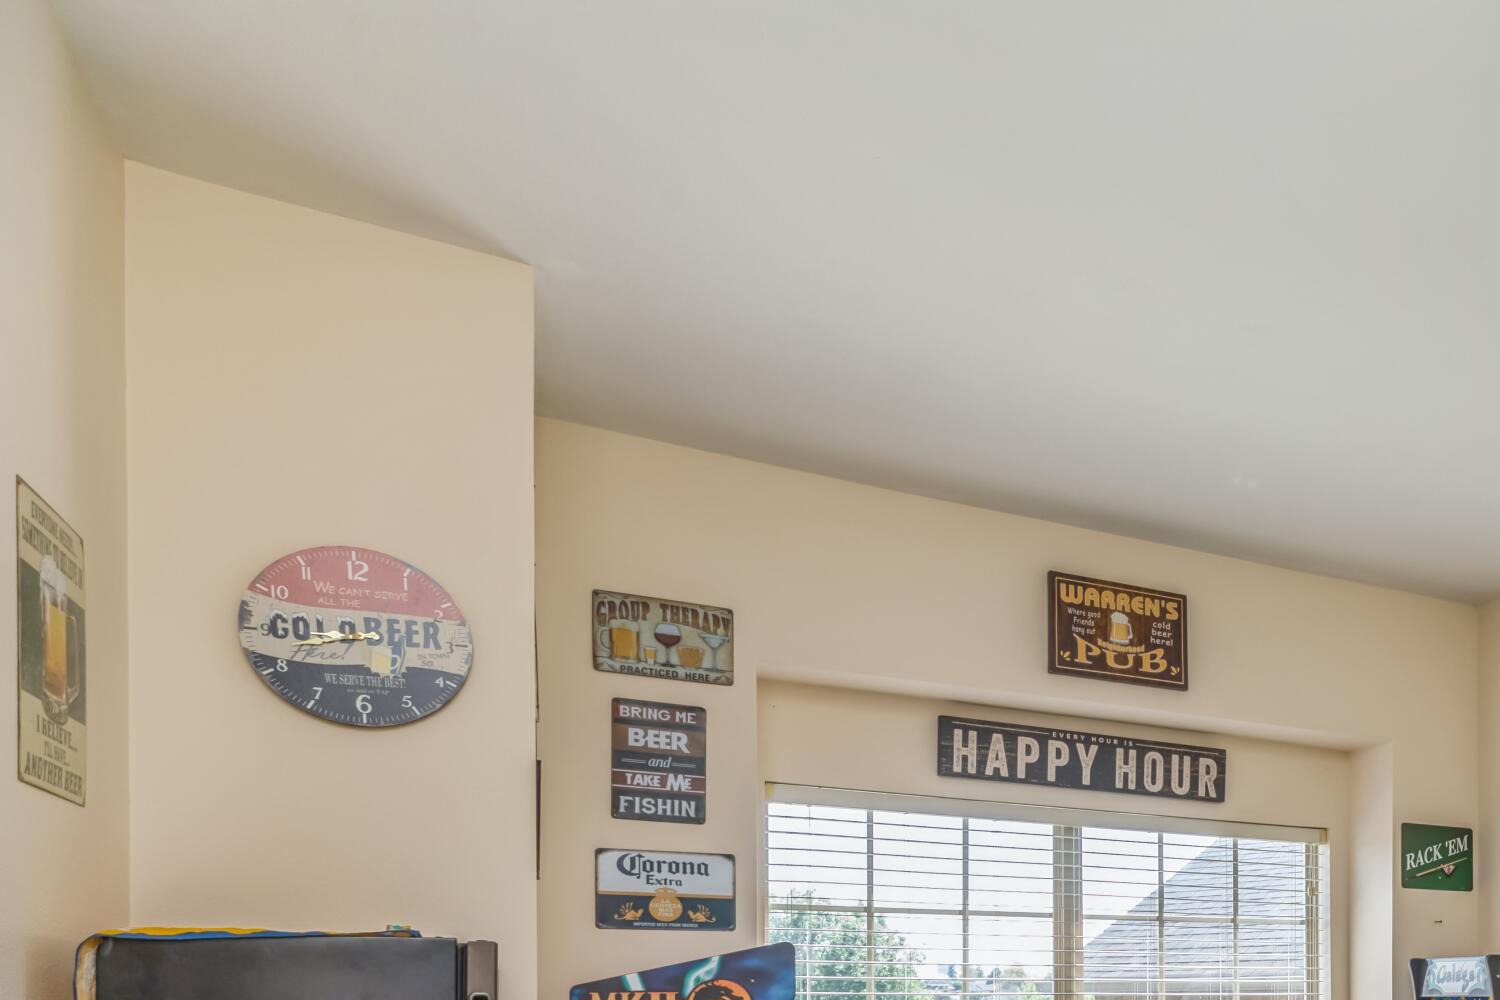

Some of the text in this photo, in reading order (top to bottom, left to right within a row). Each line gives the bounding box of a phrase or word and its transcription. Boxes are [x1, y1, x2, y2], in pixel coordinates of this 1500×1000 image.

[301, 565, 311, 581] 11
[347, 560, 369, 582] 12
[403, 577, 408, 591] 1
[270, 584, 289, 600] 10
[1060, 582, 1179, 620] WARREN'S
[433, 609, 444, 623] 2
[596, 599, 731, 637] GROUP THERAPY
[1067, 607, 1101, 619] Where good
[1073, 616, 1095, 627] Friends
[1153, 621, 1171, 630] cold
[363, 616, 441, 650] BEER
[1072, 624, 1085, 635] hang
[1151, 629, 1172, 638] beer
[445, 641, 454, 654] 3
[1150, 637, 1173, 646] here!
[1073, 633, 1168, 673] PUB
[276, 659, 288, 672] 8
[620, 664, 711, 681] PRACTICED HERE
[324, 672, 338, 686] WE
[339, 674, 366, 687] SERVE
[366, 676, 383, 687] THE
[434, 676, 444, 688] 4
[312, 686, 323, 700] 7
[355, 694, 372, 714] 6
[401, 695, 412, 708] 5
[619, 704, 697, 724] BRING ME
[628, 727, 691, 754] BEER
[1052, 731, 1085, 741] EVERY
[1091, 736, 1118, 745] HOUR
[648, 756, 672, 769] and
[953, 728, 1218, 798] HAPPY HOUR
[625, 773, 692, 791] TAKE ME
[619, 795, 696, 818] FISHIN
[1405, 834, 1469, 871] RACK 'EM
[616, 853, 710, 879] Corona
[646, 874, 683, 887] Extra
